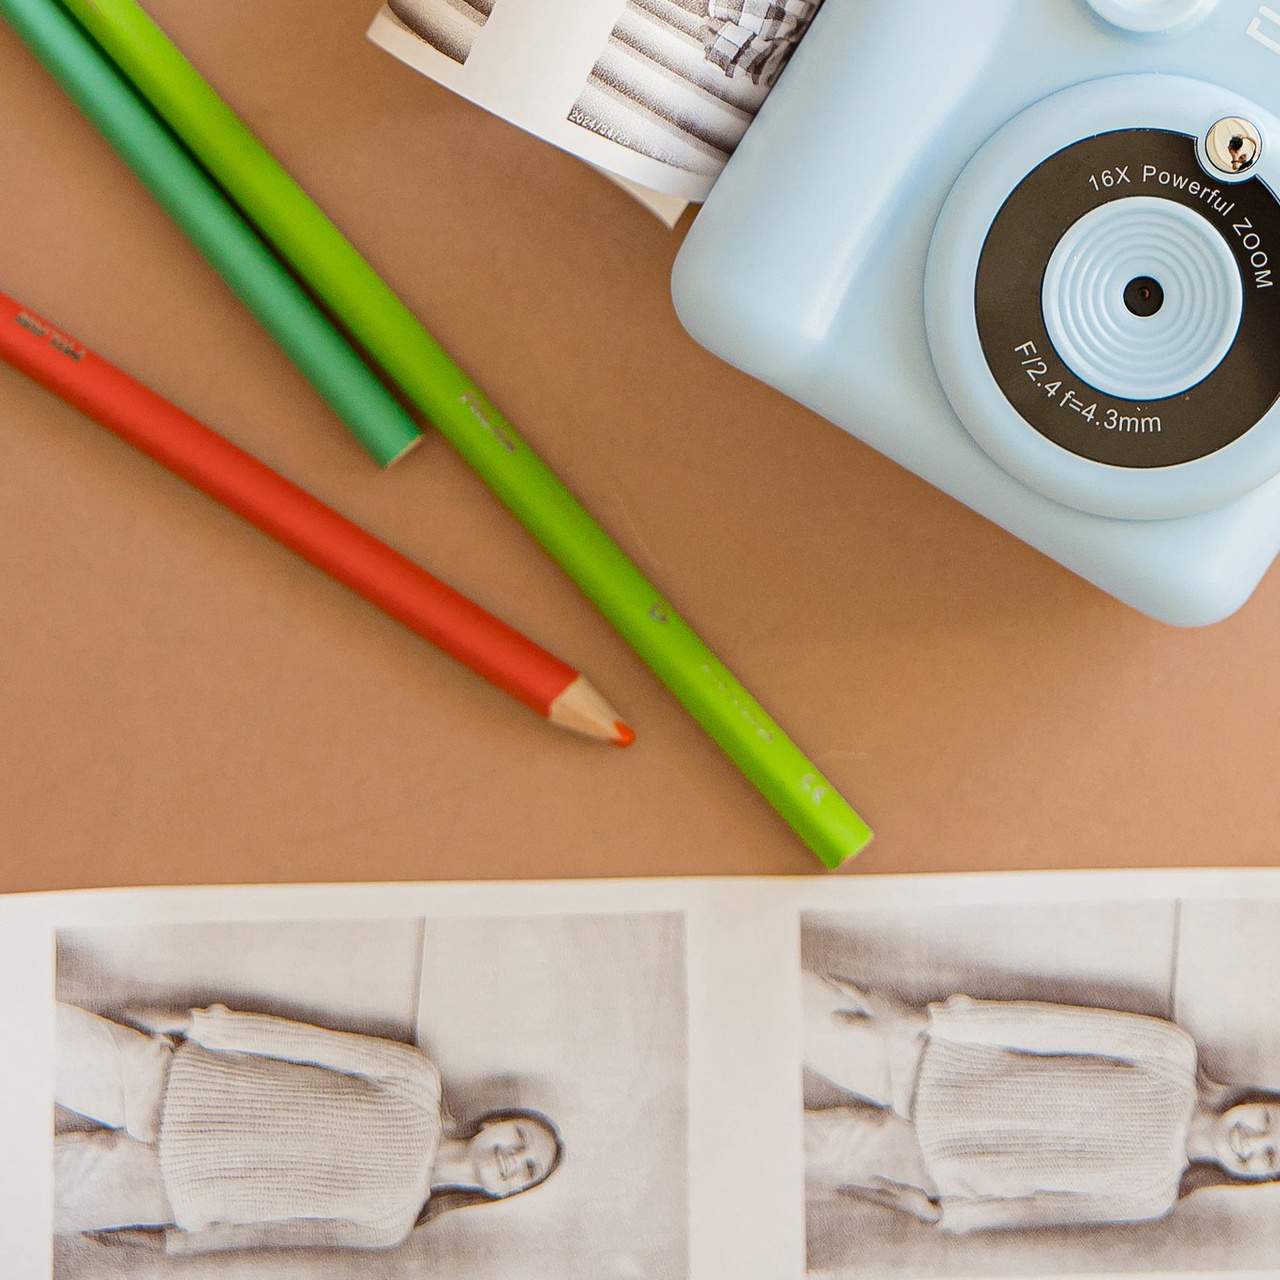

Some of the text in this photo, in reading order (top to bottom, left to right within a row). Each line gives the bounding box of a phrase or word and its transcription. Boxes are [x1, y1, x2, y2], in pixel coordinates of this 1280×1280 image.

[1088, 164, 1274, 289] 16X Powerful ZOOM
[1014, 340, 1162, 433] F/2.4 f=4.3mm
